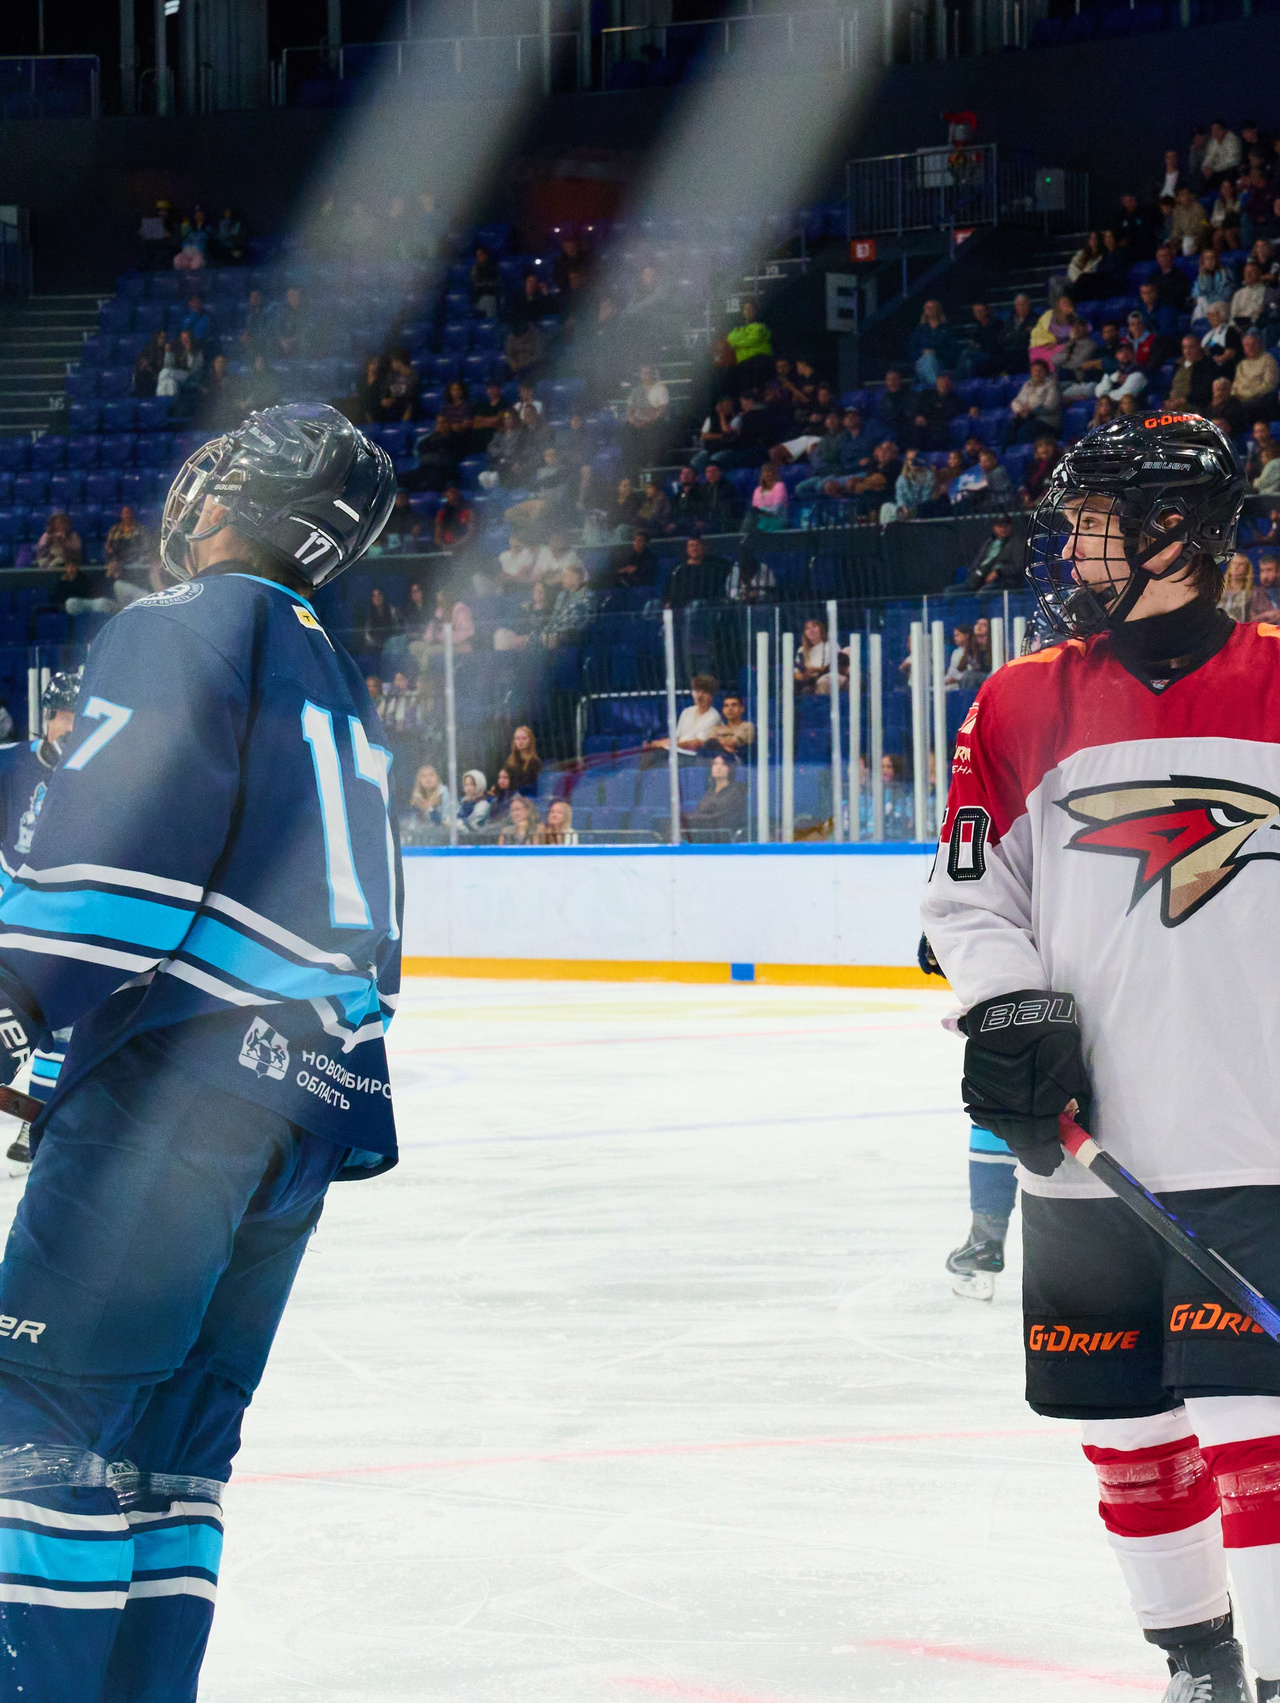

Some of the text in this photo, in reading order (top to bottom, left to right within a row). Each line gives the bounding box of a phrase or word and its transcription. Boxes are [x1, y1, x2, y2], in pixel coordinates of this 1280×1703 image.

[1141, 461, 1192, 471] BAUER
[294, 531, 333, 566] 17
[63, 696, 134, 770] 7
[301, 699, 400, 940] 17
[929, 805, 991, 883] 0
[980, 998, 1079, 1032] BAU
[296, 1070, 351, 1111] ОБЛАСТЬ
[1169, 1303, 1267, 1336] G-DRI
[1029, 1324, 1141, 1356] G-DRIVE
